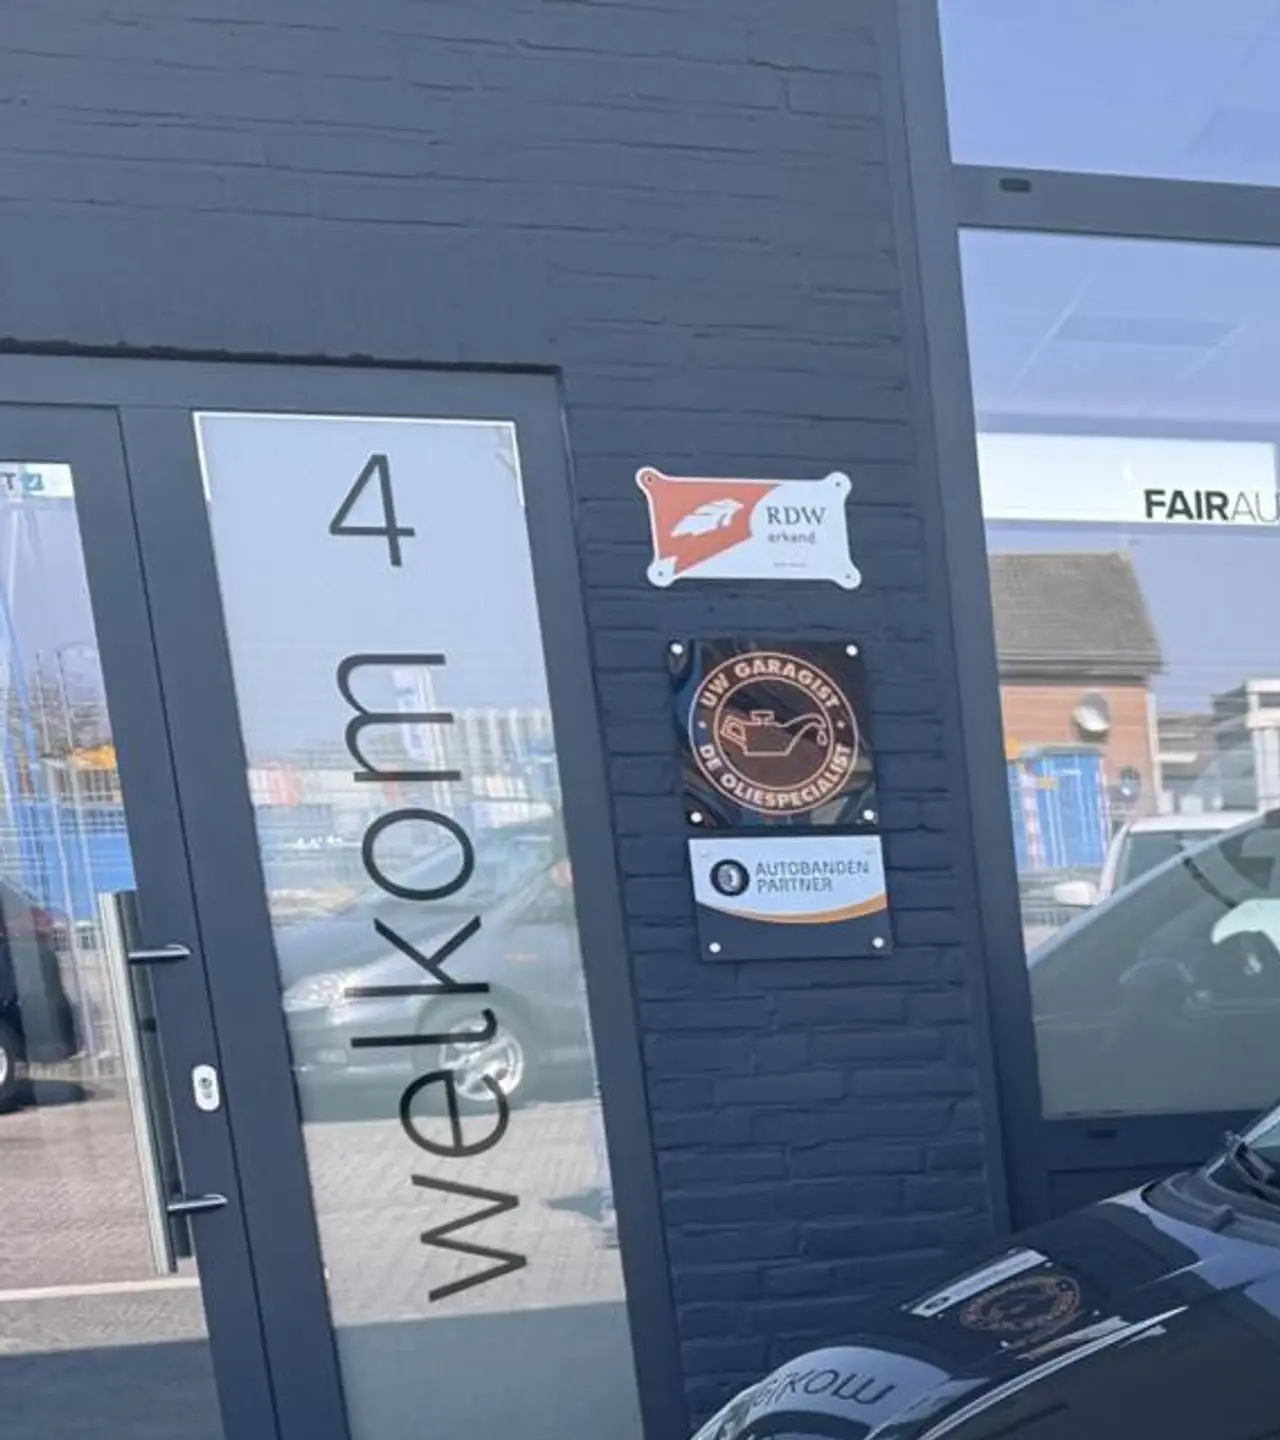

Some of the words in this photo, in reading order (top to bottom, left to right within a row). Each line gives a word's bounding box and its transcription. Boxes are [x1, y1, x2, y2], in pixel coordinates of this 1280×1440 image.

[328, 453, 415, 568] 4
[766, 506, 827, 526] RDW
[768, 530, 817, 545] erkend
[700, 673, 730, 707] UW
[734, 659, 841, 707] GARAGIST
[699, 743, 723, 770] DE
[720, 743, 852, 808] OLIESPECIALIST
[755, 860, 870, 876] AUTOBANDEN
[756, 876, 833, 894] PARTNER
[336, 653, 527, 1303] welkom
